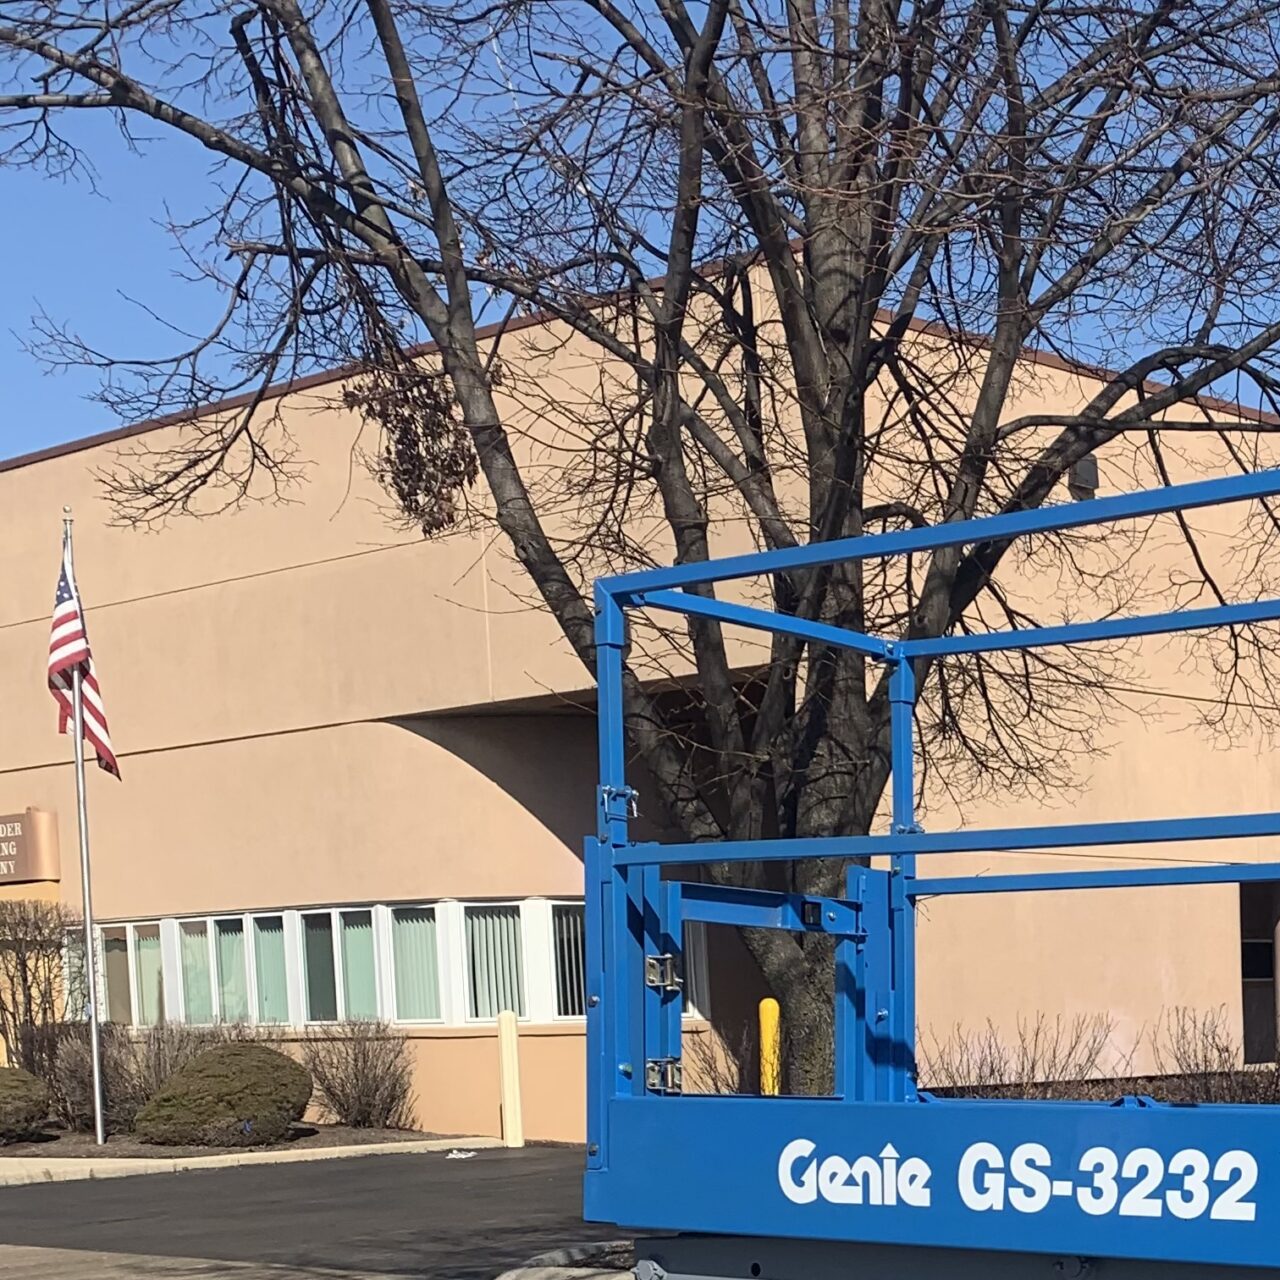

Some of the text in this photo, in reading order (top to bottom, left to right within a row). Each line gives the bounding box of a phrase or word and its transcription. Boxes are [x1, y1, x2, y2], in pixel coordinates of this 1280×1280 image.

[0, 822, 22, 837] DER
[778, 1138, 1259, 1222] Genie GS-3232
